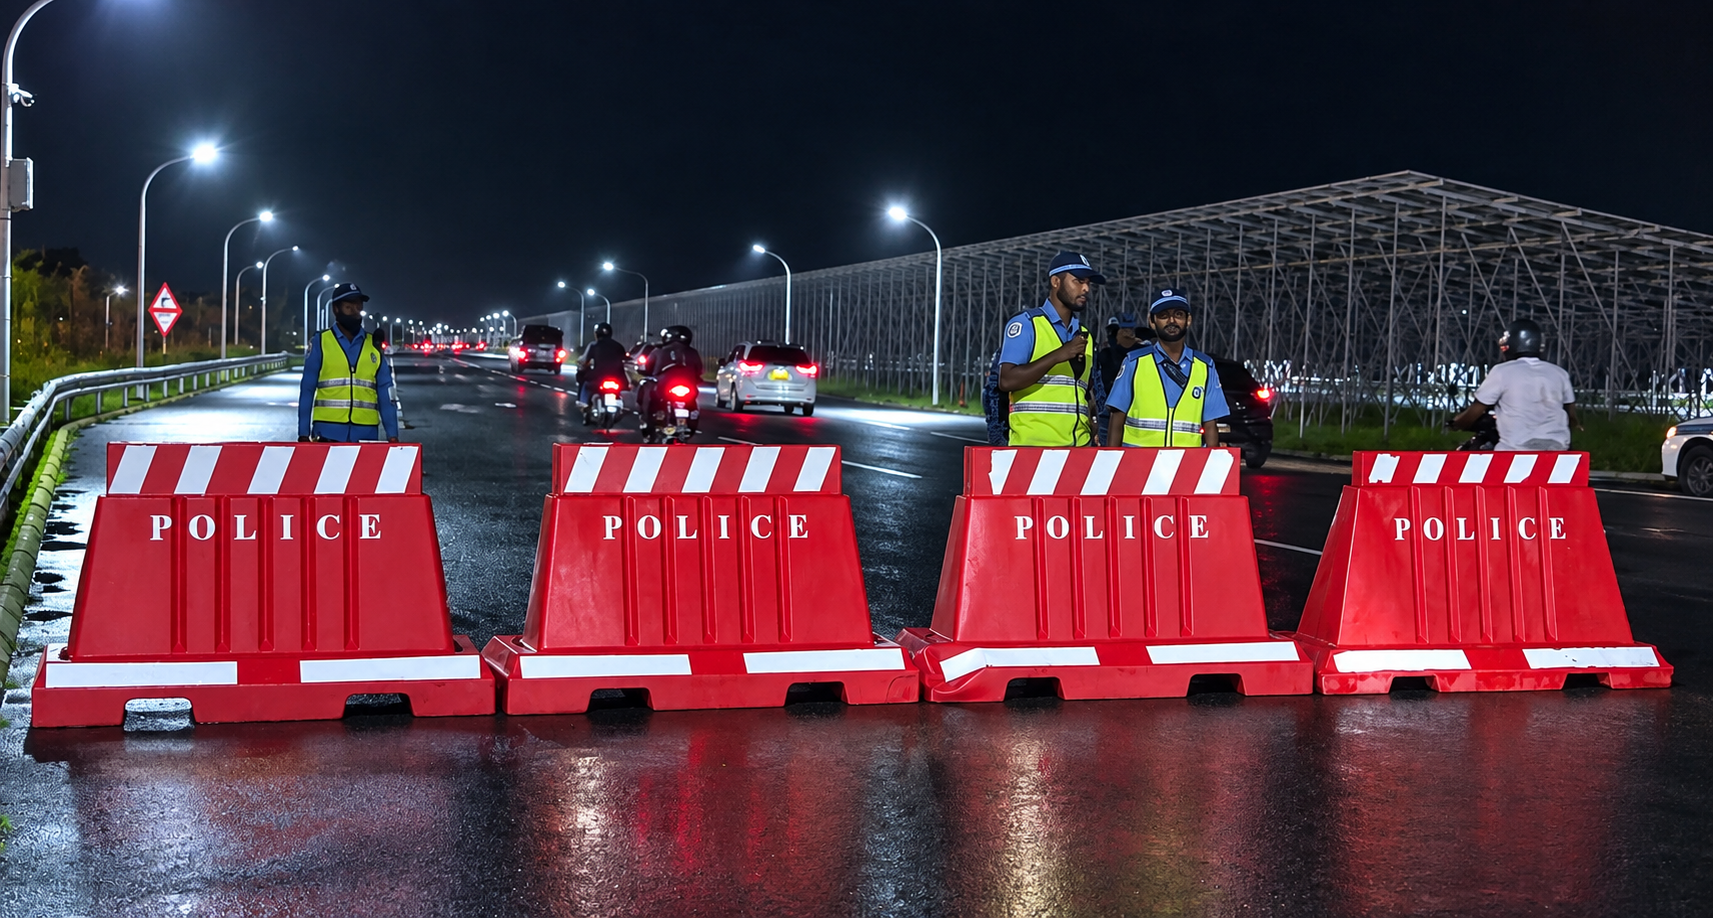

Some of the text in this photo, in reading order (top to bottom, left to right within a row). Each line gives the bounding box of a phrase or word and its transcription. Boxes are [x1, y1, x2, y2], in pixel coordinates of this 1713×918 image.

[150, 514, 381, 541] POLICE
[603, 514, 809, 540] POLICE
[1015, 514, 1209, 540] POLICE
[1394, 516, 1567, 541] POLICE
